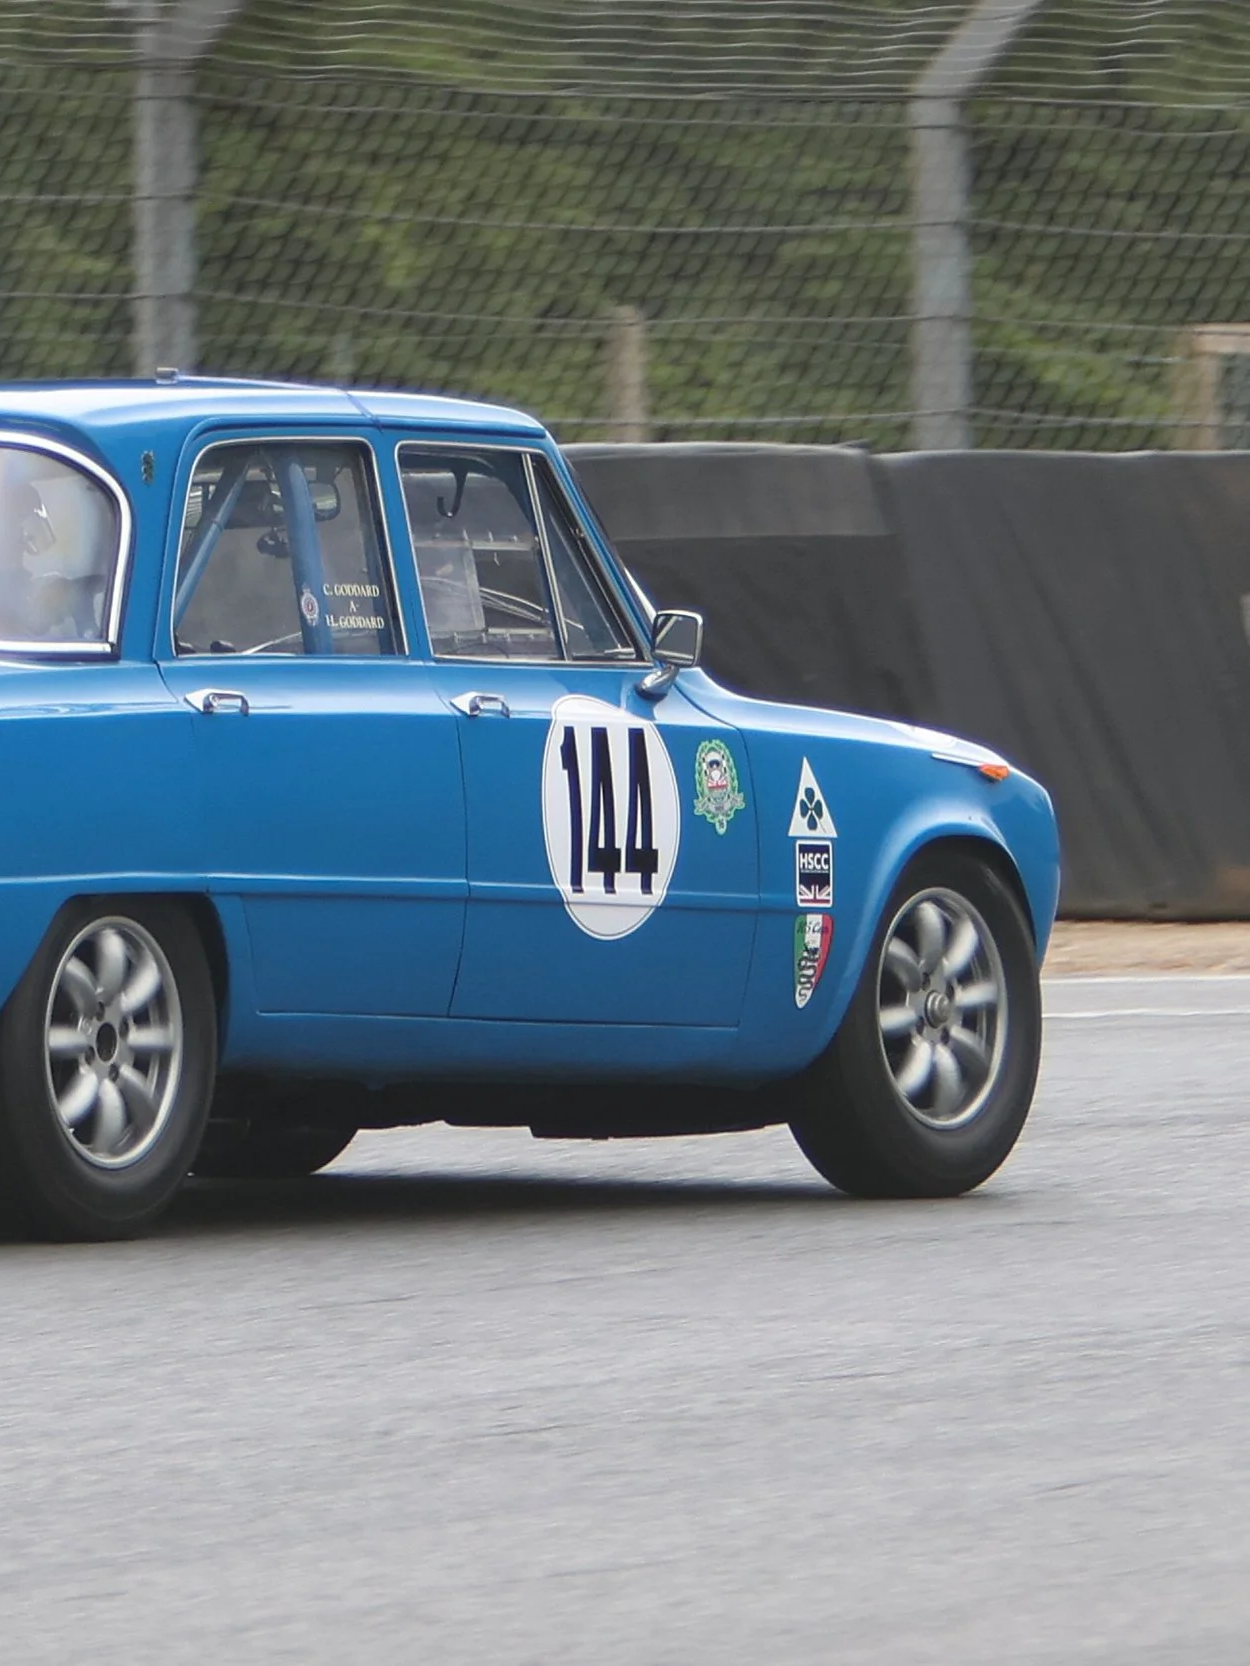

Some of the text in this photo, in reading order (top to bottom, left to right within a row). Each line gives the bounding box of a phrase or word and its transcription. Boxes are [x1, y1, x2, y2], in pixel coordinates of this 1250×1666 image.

[323, 583, 380, 597] C. GODDARD
[339, 615, 385, 629] GODDARD
[560, 725, 659, 896] 144
[799, 852, 829, 870] HSCC
